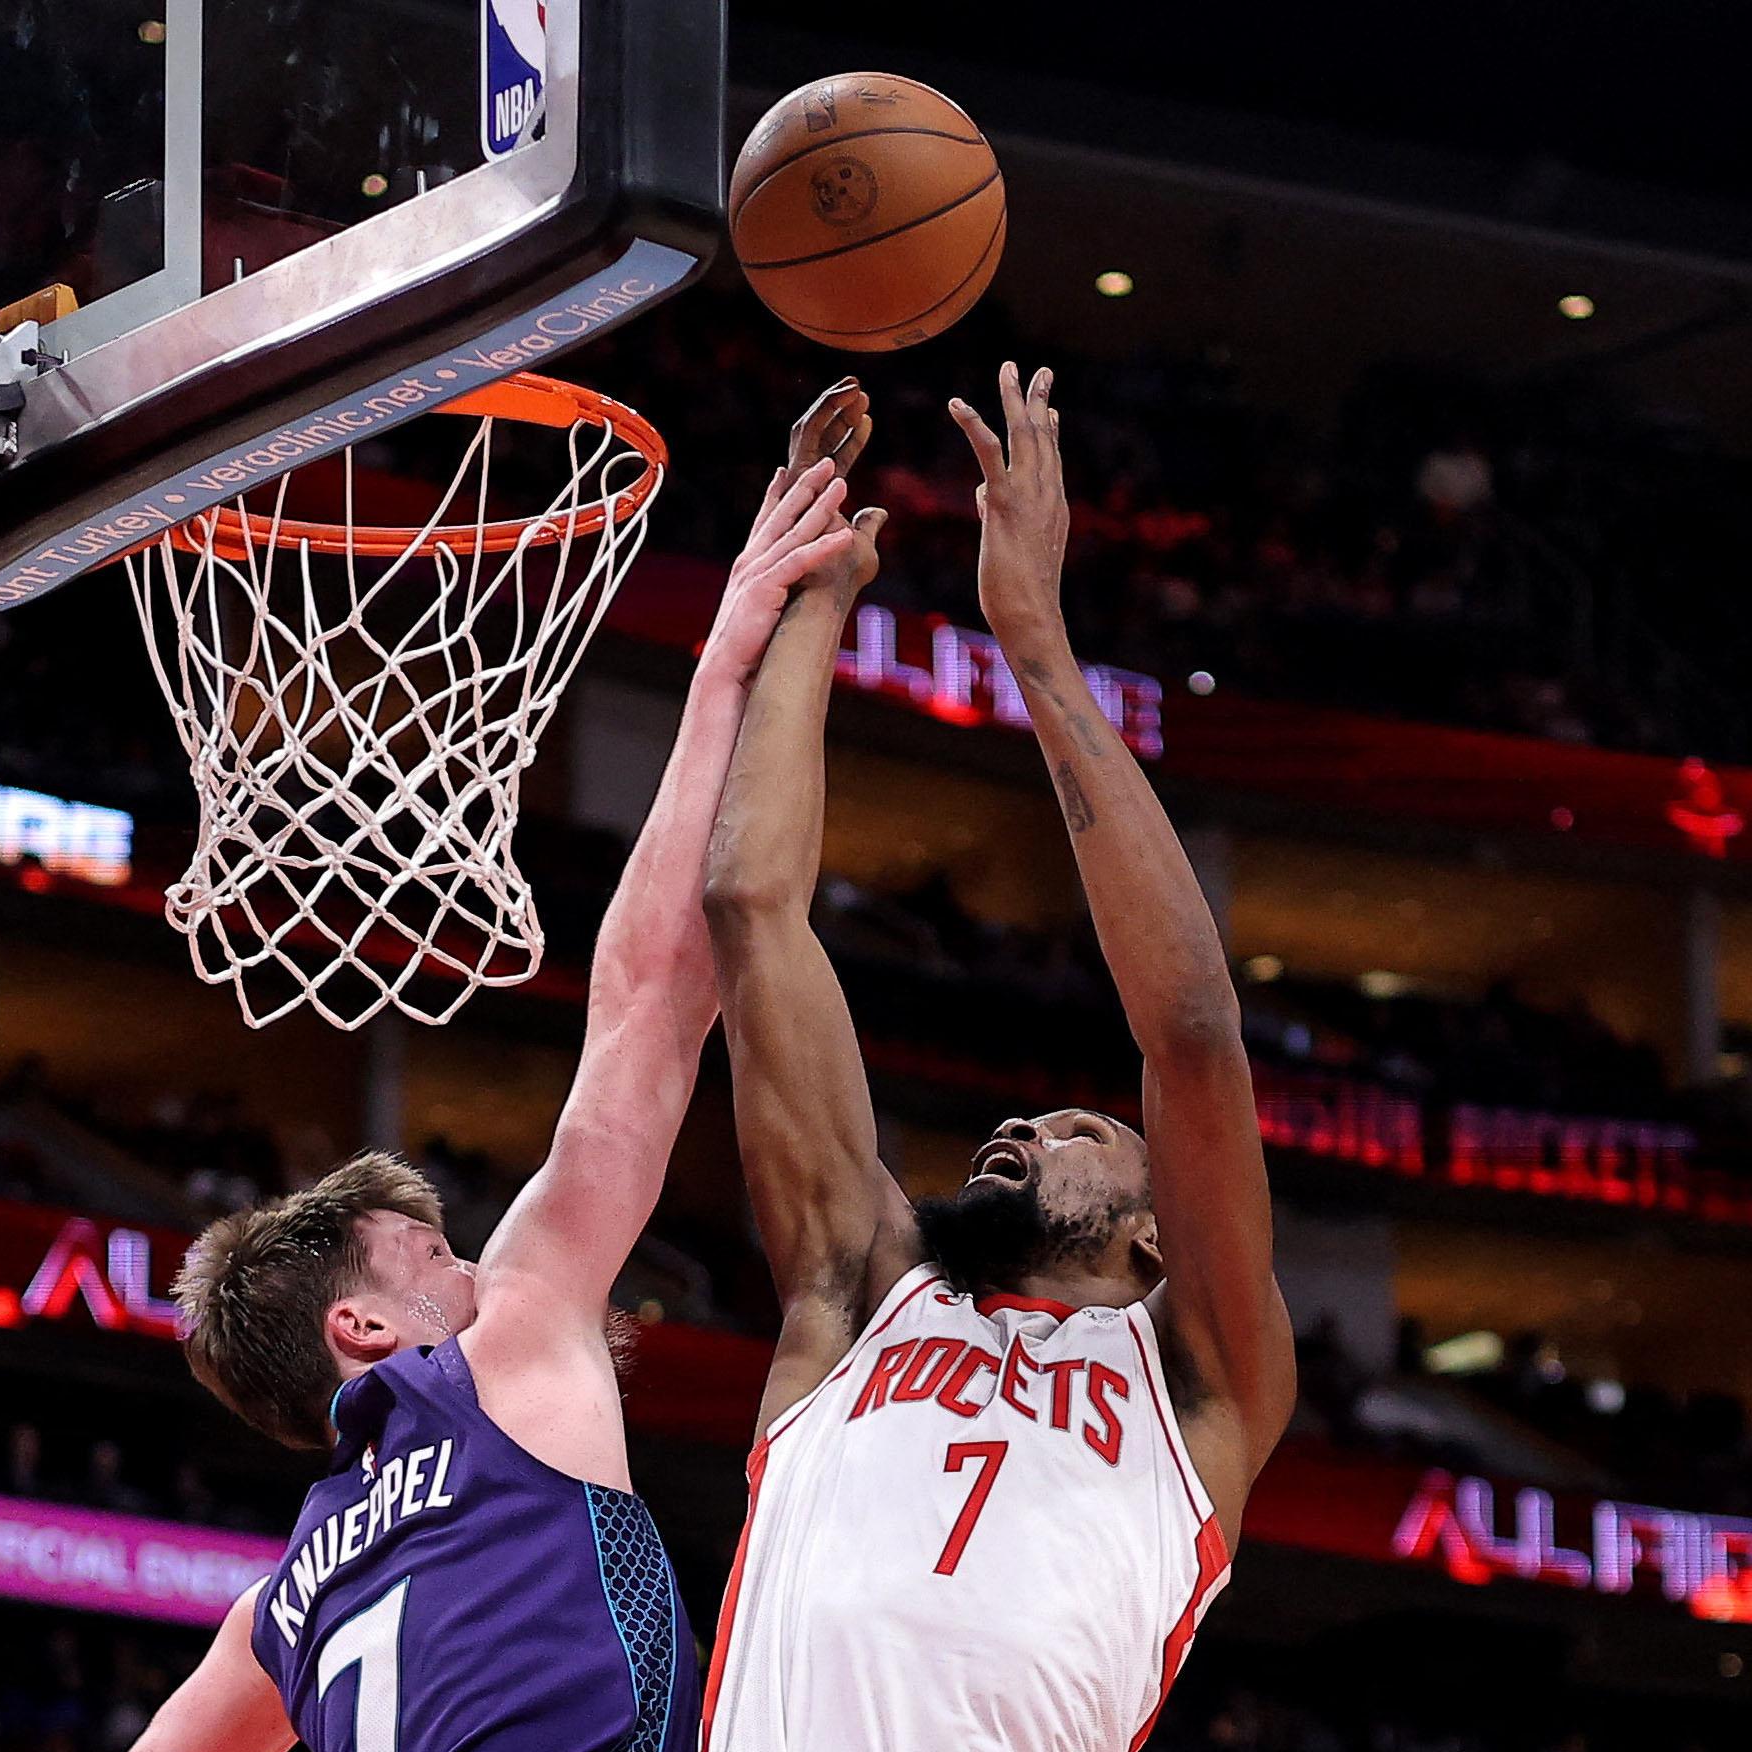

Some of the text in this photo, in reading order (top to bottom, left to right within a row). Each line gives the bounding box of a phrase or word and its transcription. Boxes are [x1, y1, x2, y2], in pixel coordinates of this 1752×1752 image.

[495, 78, 536, 142] NBA
[36, 504, 177, 564] Turkey
[185, 378, 443, 491] veraclinic.net
[452, 279, 656, 370] VeraClinic
[846, 1333, 1130, 1468] ROCETS
[270, 1438, 454, 1649] KNUEPPEL
[933, 1440, 1009, 1576] 7
[1391, 1467, 1593, 1590] ALL
